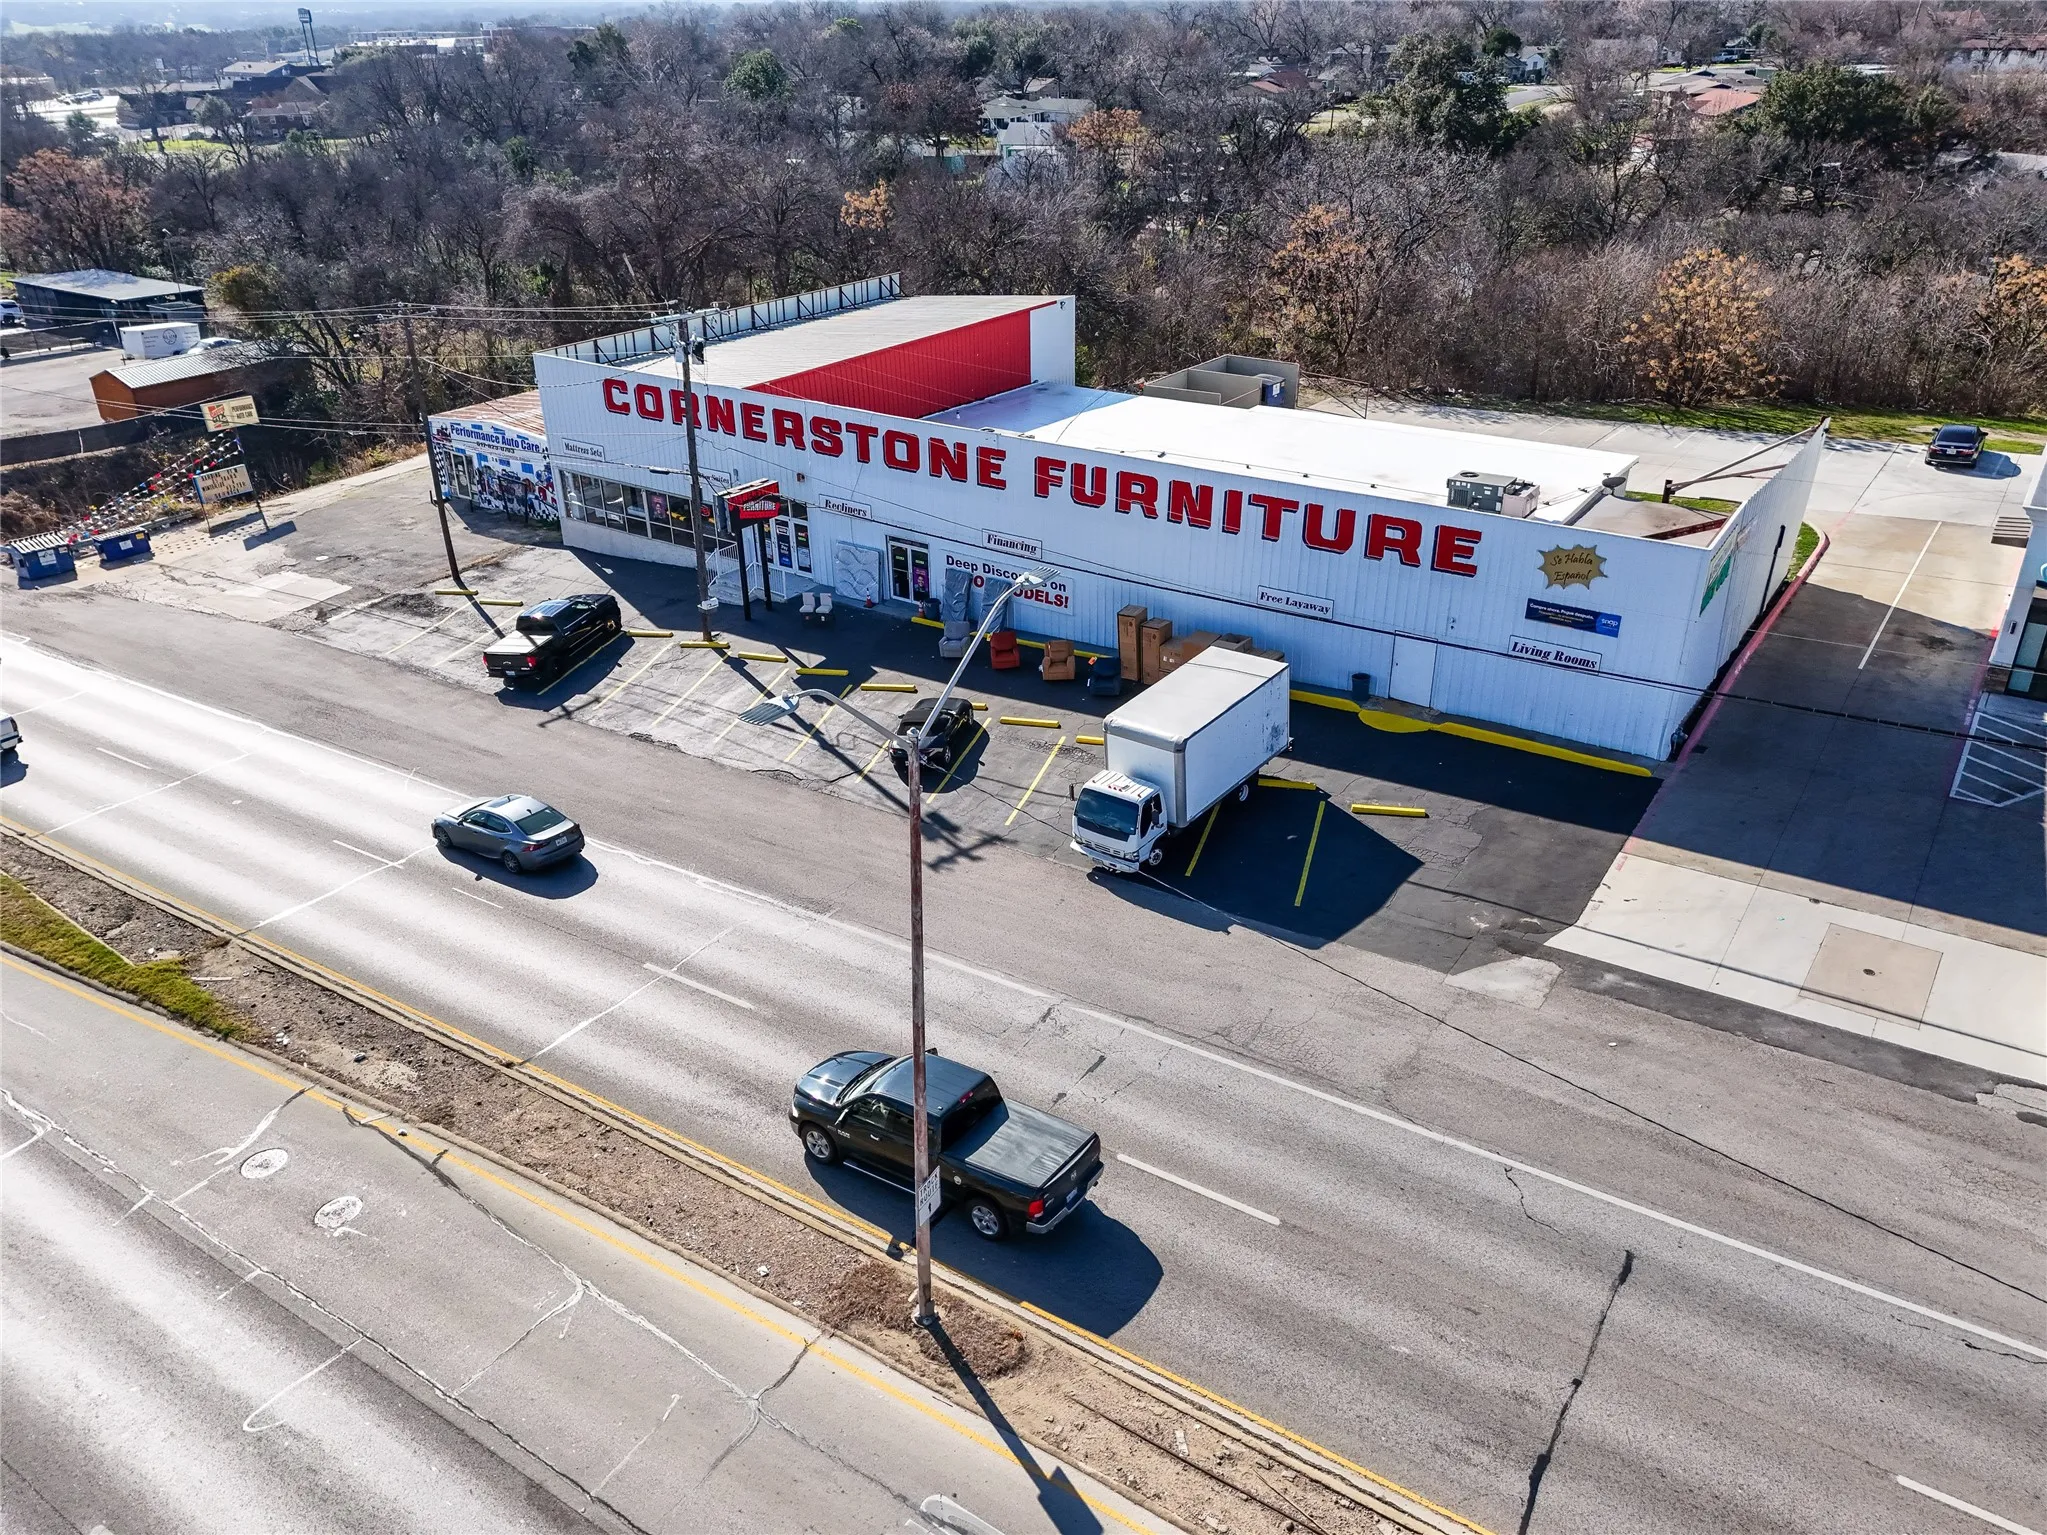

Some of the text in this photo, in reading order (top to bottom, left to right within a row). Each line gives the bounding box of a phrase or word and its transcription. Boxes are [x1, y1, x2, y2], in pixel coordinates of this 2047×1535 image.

[450, 424, 500, 444] Performance
[502, 436, 519, 448] Auto
[521, 439, 540, 453] Care
[564, 442, 603, 458] Mattress Sets
[603, 378, 1482, 578] CORNERSTONE FURNITURE
[743, 500, 776, 511] FURNITURE
[825, 499, 868, 517] Recliners
[987, 533, 1038, 555] Financing
[1550, 552, 1594, 567] Se Habla
[946, 555, 979, 573] Deep
[1050, 581, 1067, 592] on
[1554, 570, 1592, 585] Español
[1260, 591, 1331, 615] Free Layaway
[1601, 618, 1618, 627] snap
[1511, 641, 1598, 669] Living Rooms
[919, 1173, 938, 1197] TRUCK
[919, 1183, 938, 1206] ROUTE
